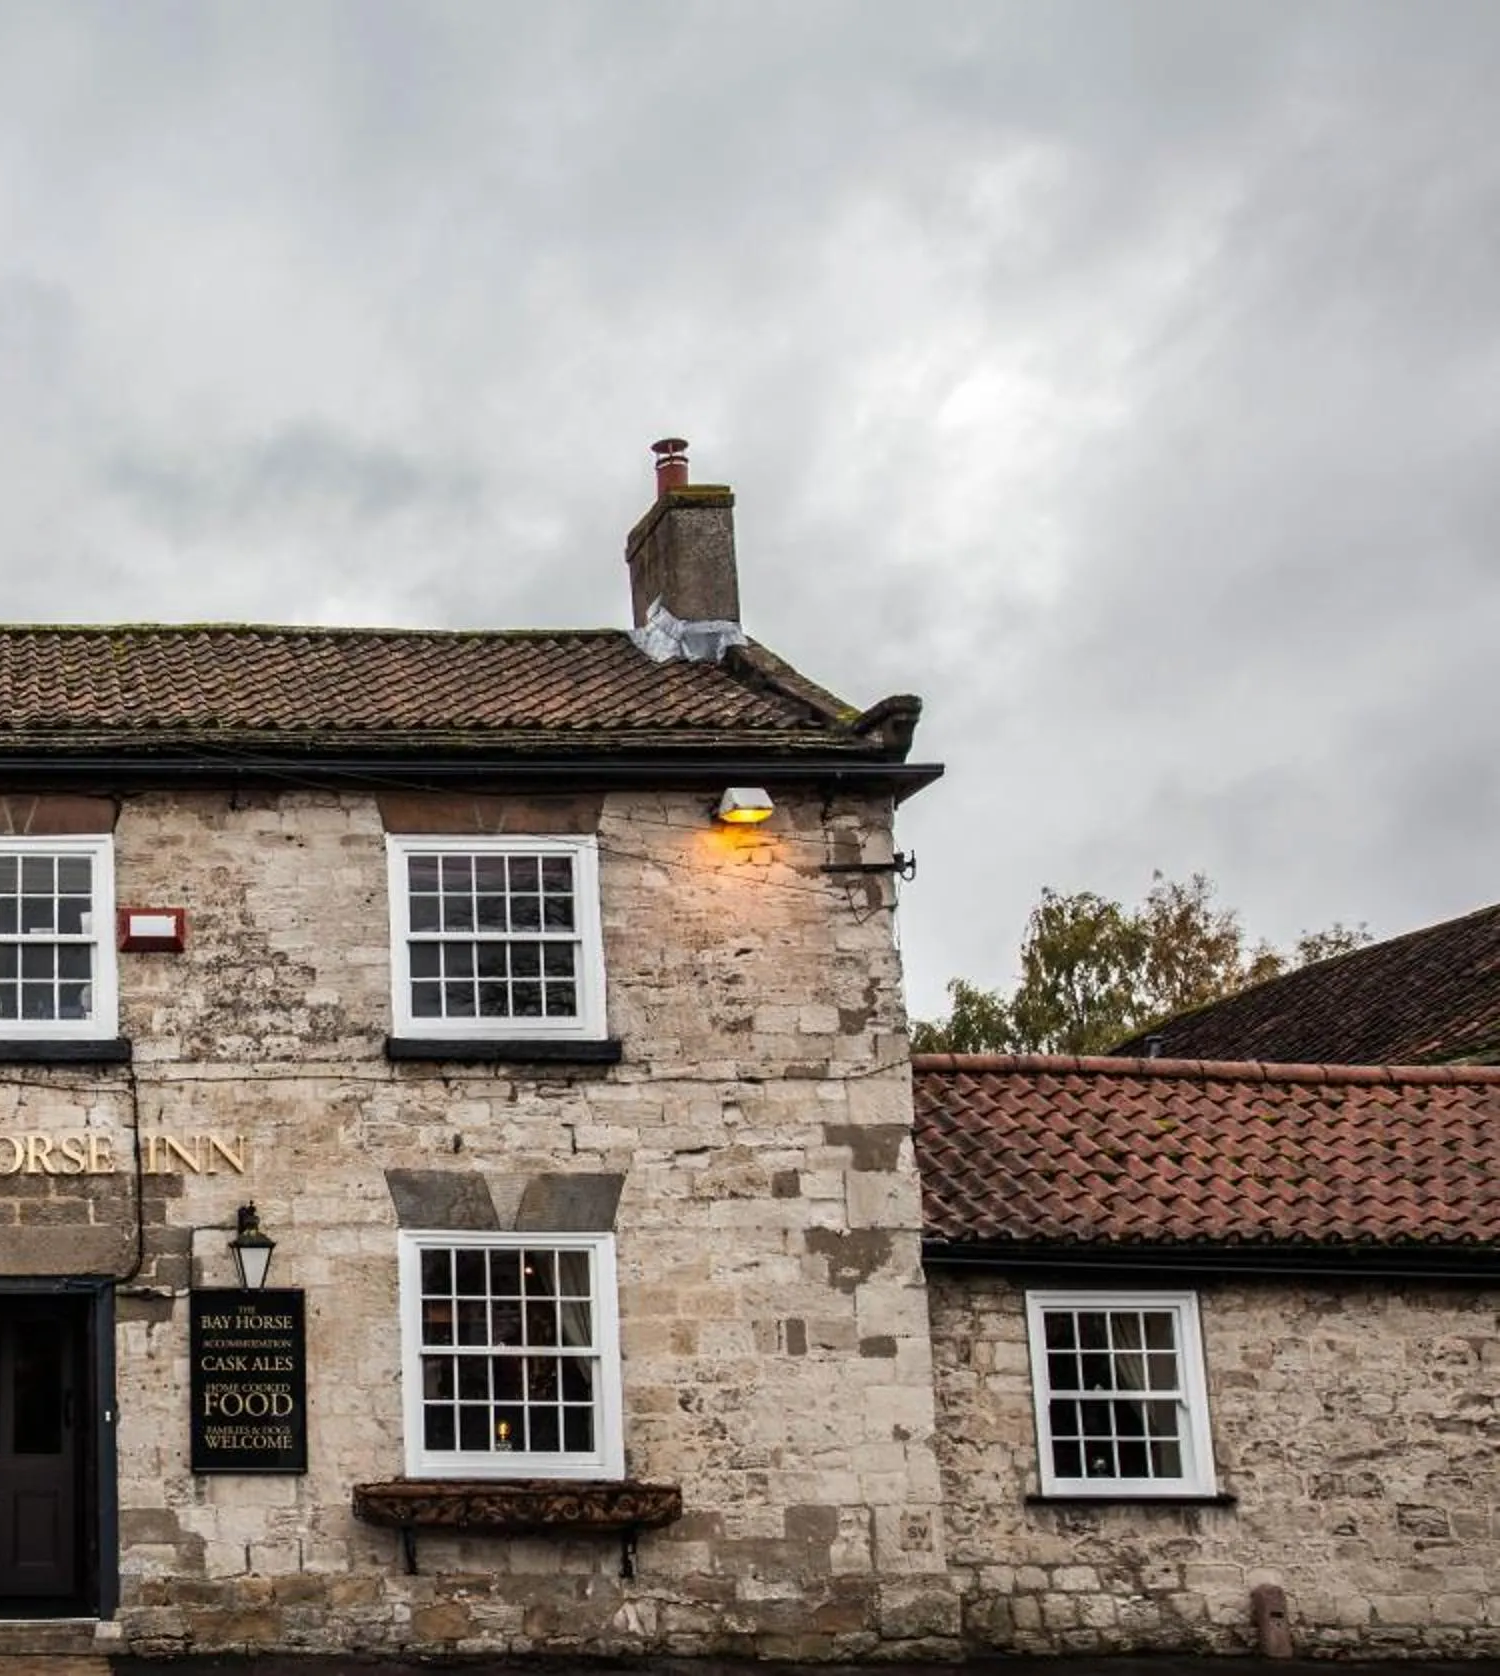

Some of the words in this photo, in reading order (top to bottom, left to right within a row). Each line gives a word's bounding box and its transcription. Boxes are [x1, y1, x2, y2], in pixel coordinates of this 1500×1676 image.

[146, 1134, 245, 1175] INN
[201, 1315, 231, 1329] BAY
[236, 1315, 293, 1329] HORSE
[201, 1355, 247, 1371] CASK
[251, 1356, 293, 1371] ALES
[204, 1391, 293, 1417] FOOD
[204, 1435, 293, 1449] WELCOME
